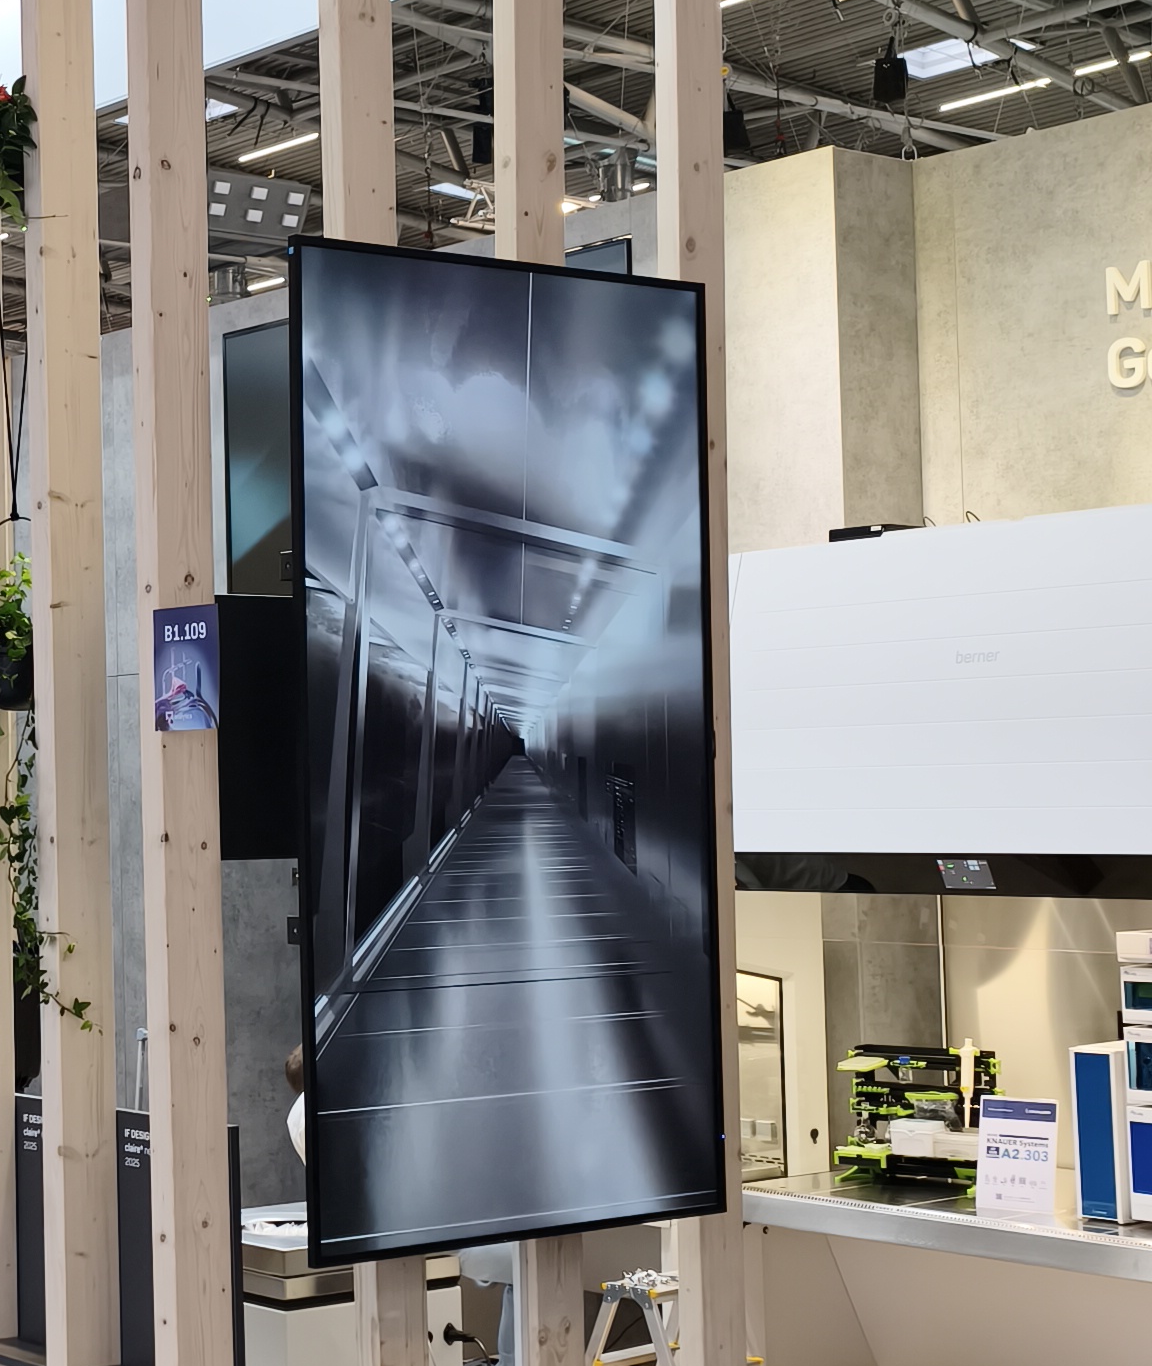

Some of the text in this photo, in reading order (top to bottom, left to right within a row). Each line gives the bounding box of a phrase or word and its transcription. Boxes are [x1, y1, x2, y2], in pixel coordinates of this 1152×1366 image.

[1107, 337, 1152, 389] G
[164, 621, 207, 642] B1.109
[955, 649, 1000, 664] berner
[986, 1137, 1018, 1146] KNAUER
